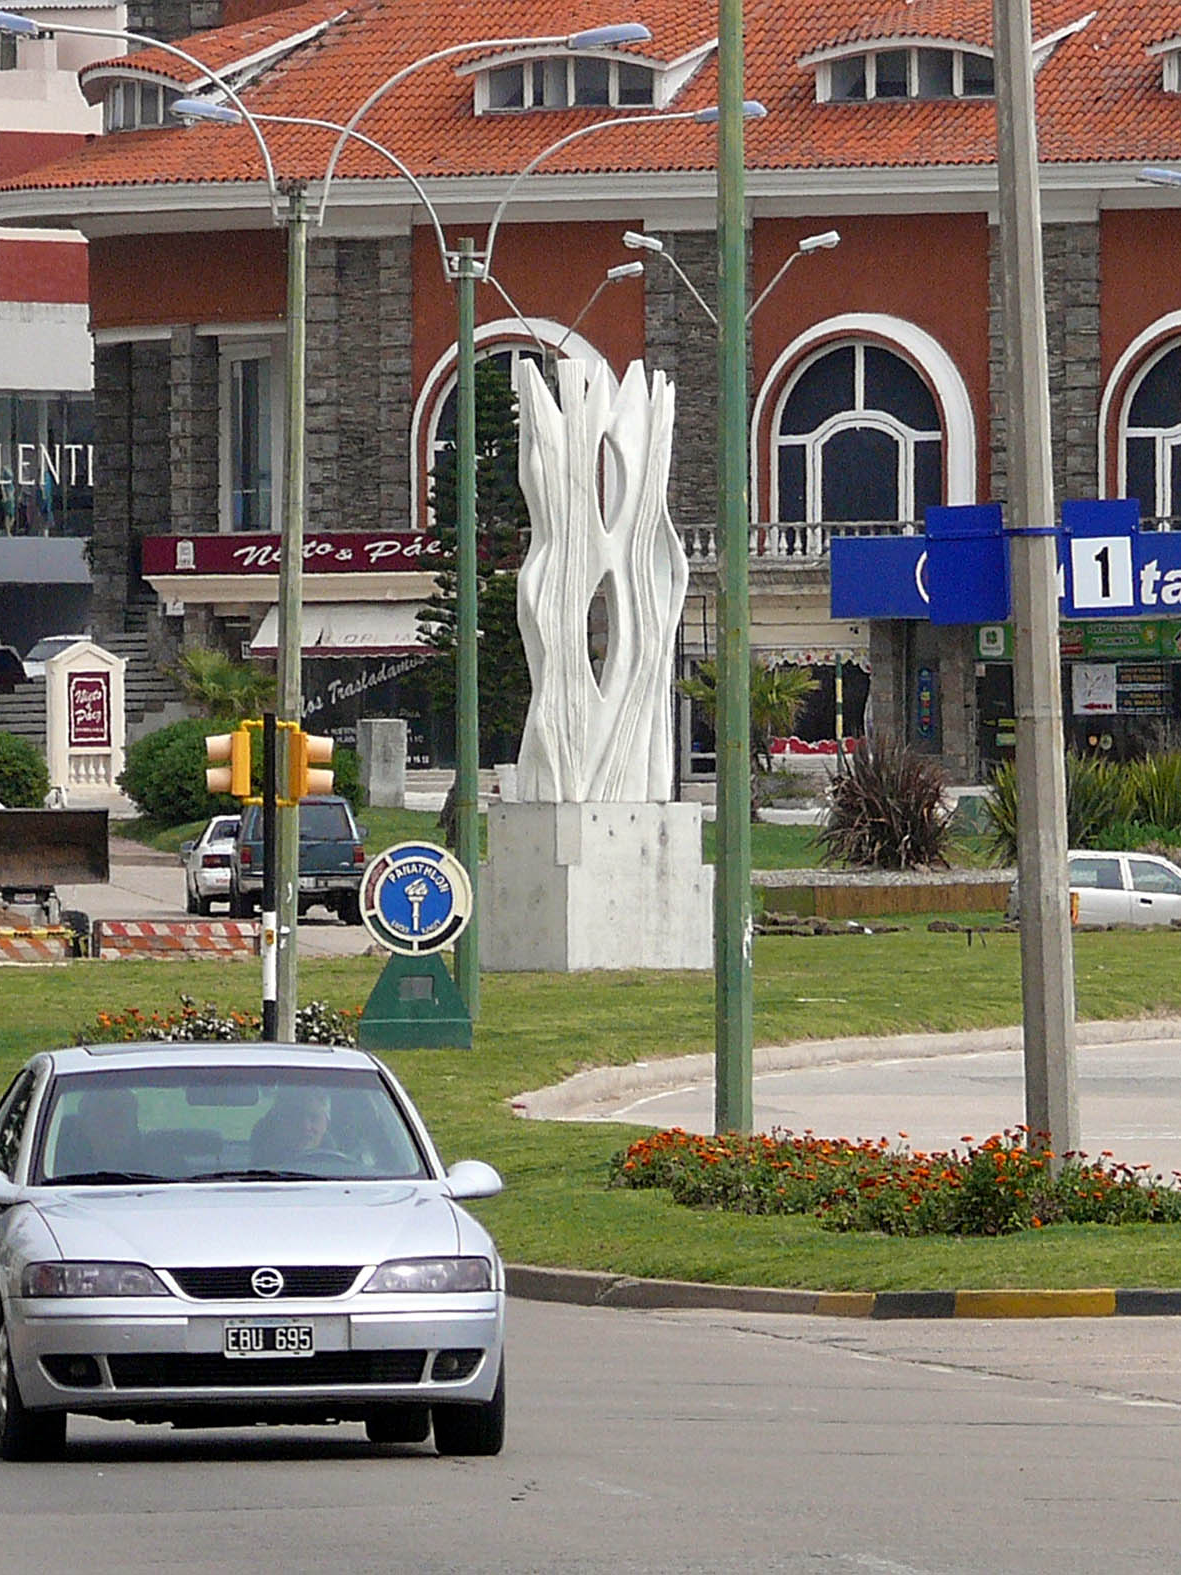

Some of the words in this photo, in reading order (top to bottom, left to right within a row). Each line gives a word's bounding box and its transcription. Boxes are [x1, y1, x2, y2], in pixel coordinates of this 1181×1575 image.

[334, 548, 353, 561] &
[1094, 546, 1111, 598] 1
[387, 862, 451, 894] PANATHLON
[227, 1328, 264, 1351] EBU
[274, 1327, 312, 1350] 695
